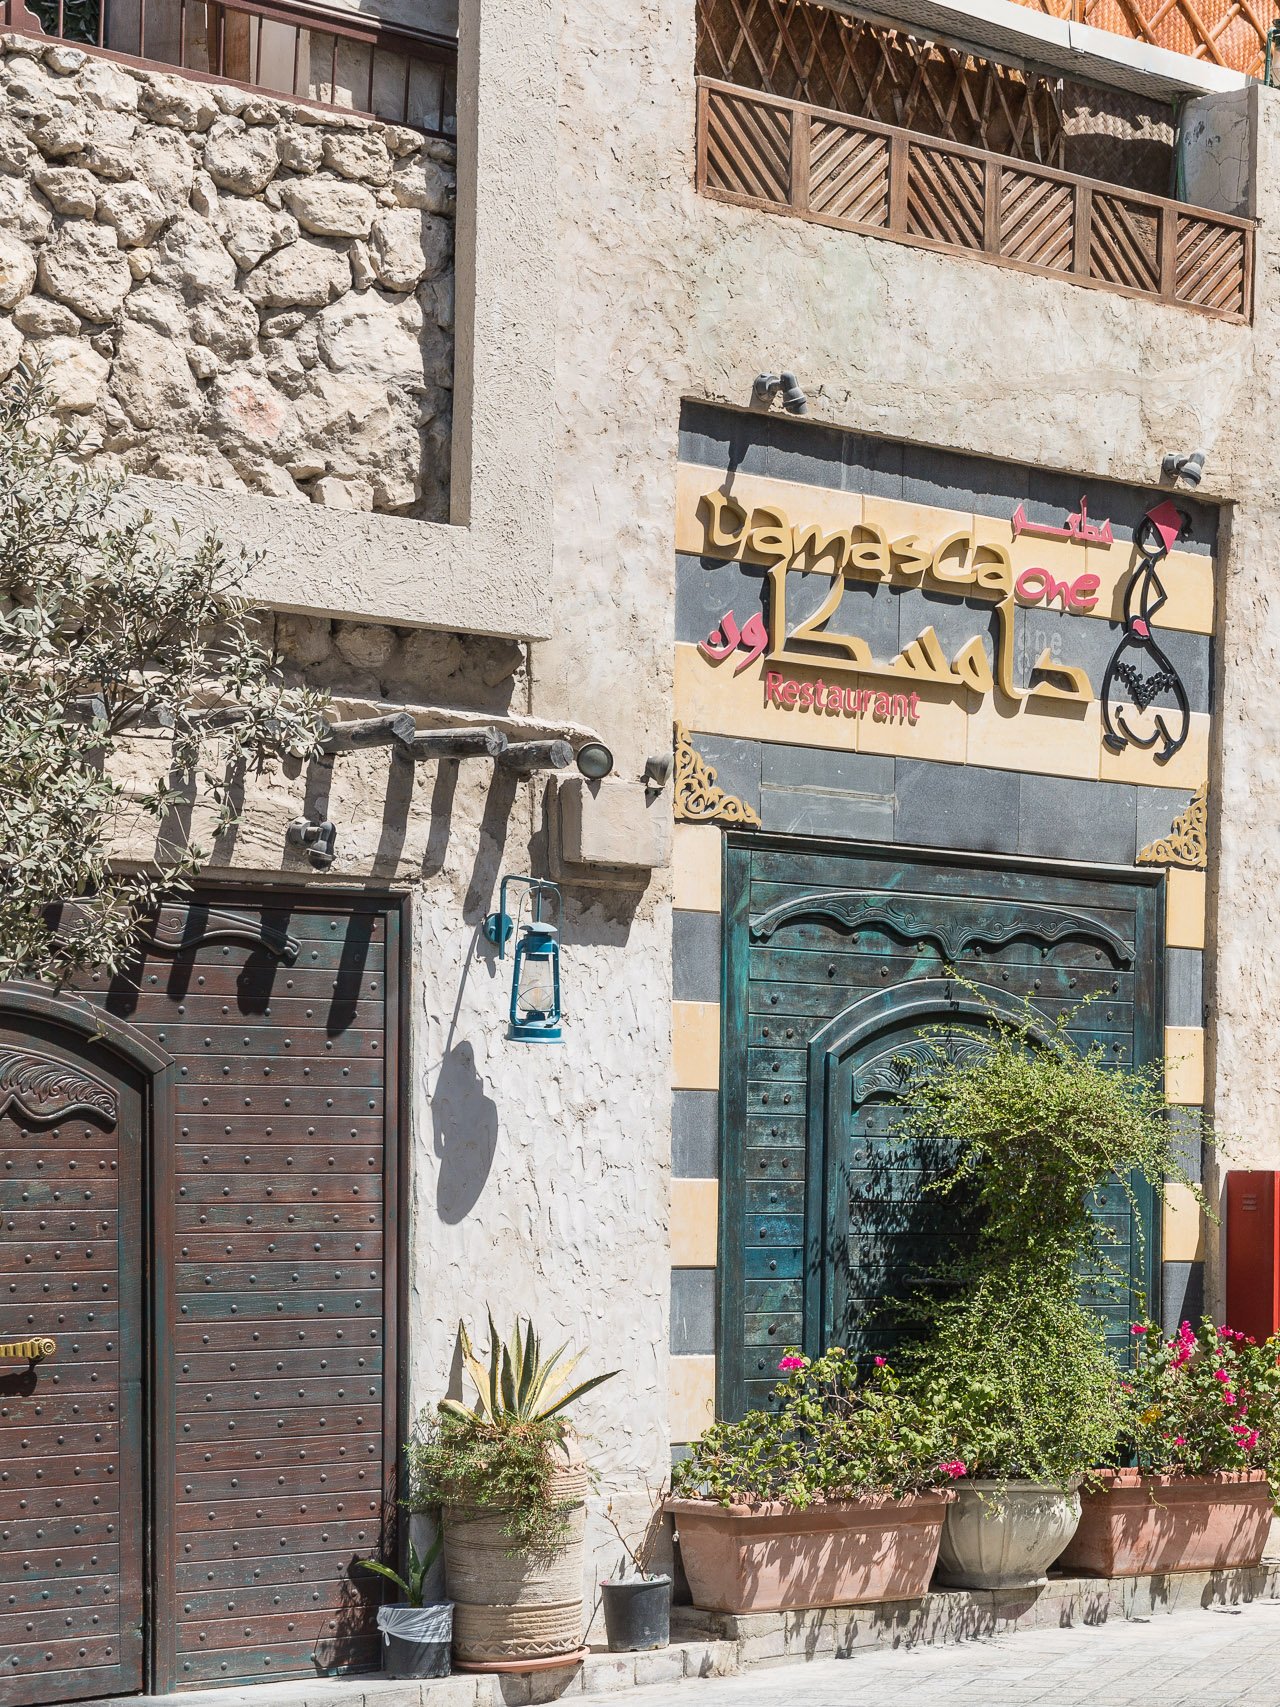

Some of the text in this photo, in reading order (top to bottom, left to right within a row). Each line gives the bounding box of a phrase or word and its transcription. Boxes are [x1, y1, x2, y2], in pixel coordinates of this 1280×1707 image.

[699, 490, 1012, 595] Damasca
[1012, 494, 1114, 544] مطعم
[698, 609, 768, 670] ون
[765, 670, 920, 721] Restaurant
